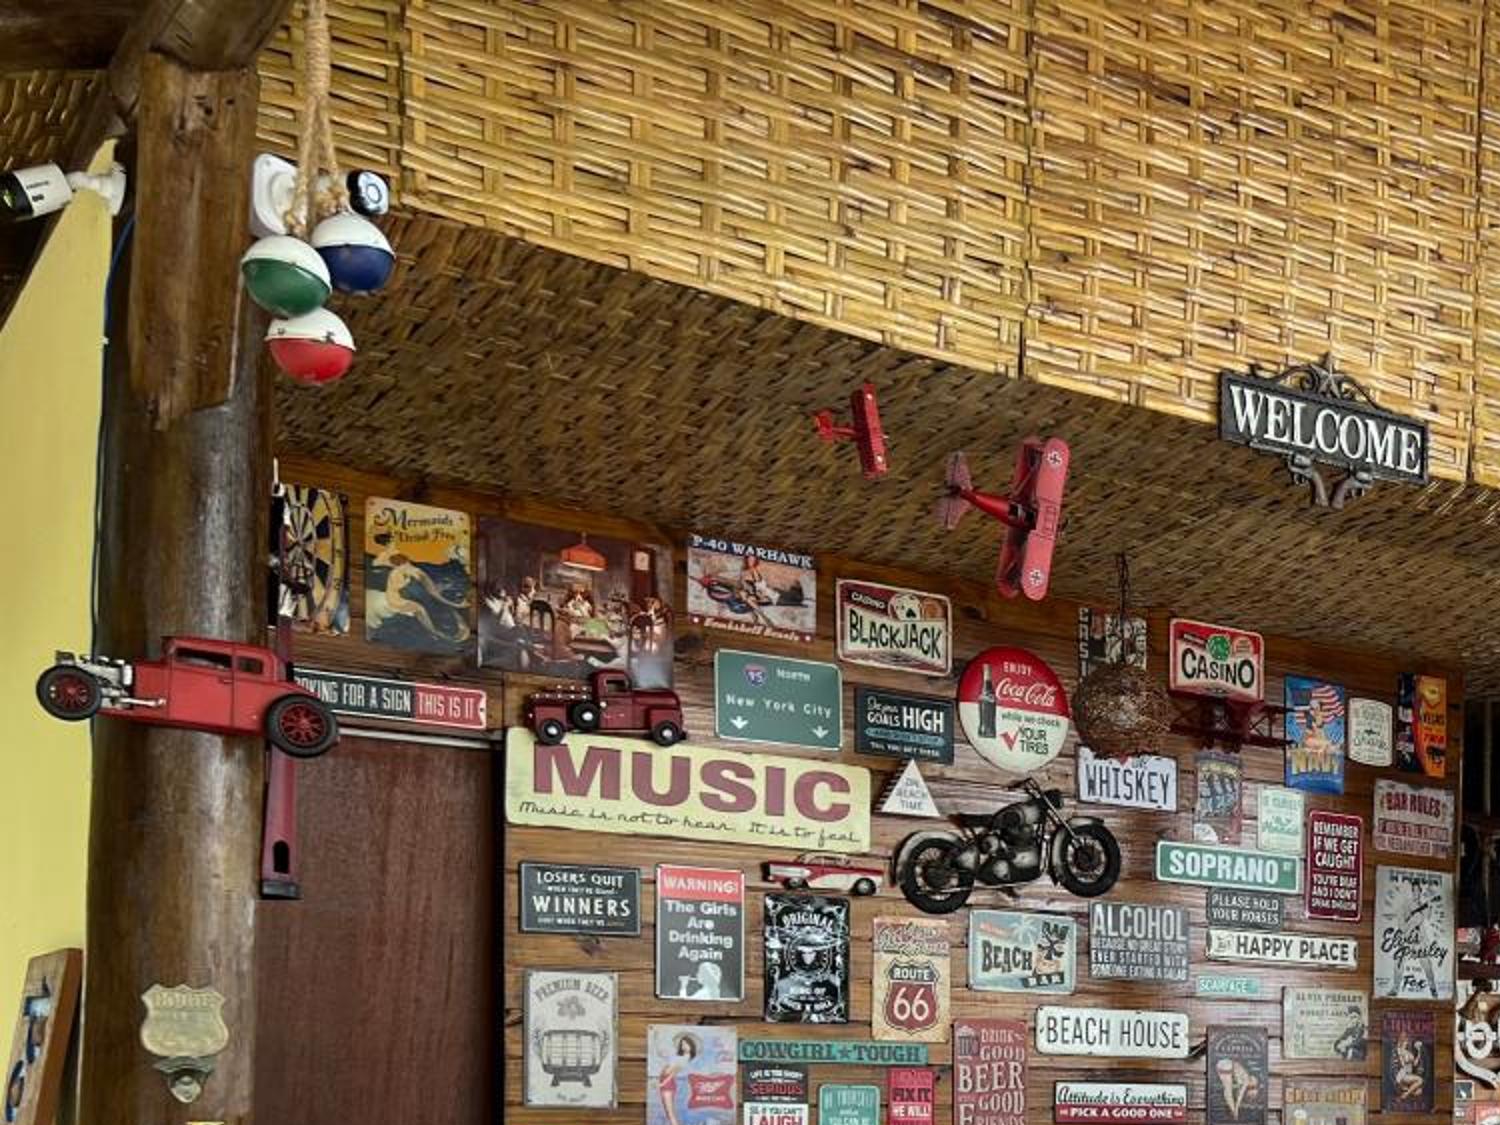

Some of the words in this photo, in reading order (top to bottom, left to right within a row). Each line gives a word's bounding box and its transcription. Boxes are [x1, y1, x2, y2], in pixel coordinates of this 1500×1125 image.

[1230, 384, 1422, 475] WELCOME
[849, 609, 943, 659] BLACKJACK
[1181, 648, 1255, 689] CASINO
[725, 693, 755, 707] New
[764, 698, 796, 714] York
[802, 702, 833, 719] City
[866, 712, 902, 727] GOALS
[902, 706, 945, 734] HIGH
[1018, 725, 1048, 742] YOUR
[1019, 739, 1049, 755] TIRES
[532, 741, 852, 824] MUSIC
[1085, 764, 1170, 805] WHISKEY
[1313, 821, 1360, 839] REMEMBER
[1313, 836, 1323, 850] IF
[1324, 837, 1339, 852] WE
[1341, 840, 1359, 855] GET
[1315, 852, 1357, 870] CAUGHT
[536, 871, 586, 886] LOSERS
[590, 873, 625, 889] QUIT
[662, 875, 739, 895] WARNING!
[531, 895, 632, 918] WINNERS
[664, 900, 695, 914] The
[699, 901, 738, 918] Girls
[1211, 893, 1251, 909] PLEASE
[1253, 896, 1280, 911] HOLD
[686, 916, 715, 931] Are
[782, 905, 837, 931] ORIGINAL
[1093, 903, 1187, 941] ALCOHOL
[1211, 907, 1239, 922] YOUR
[1241, 909, 1280, 925] HORSES
[668, 930, 734, 949] Drinking
[1236, 937, 1293, 958] HAPPY
[1300, 941, 1350, 963] PLACE
[677, 946, 724, 964] Again
[981, 939, 1033, 974] BEACH
[892, 968, 932, 982] ROUTE
[892, 986, 930, 1023] 66
[1046, 1015, 1108, 1046] BEACH
[1122, 1019, 1182, 1050] HOUSE
[741, 1041, 838, 1061] COWGIRL
[852, 1043, 921, 1064] TOUGH
[979, 1045, 1025, 1063] GOOD
[957, 1061, 1025, 1094] BEER
[892, 1104, 906, 1117] HE
[978, 1090, 1025, 1116] GOOD
[1069, 1107, 1100, 1119] PICK
[1102, 1108, 1109, 1118] A
[1111, 1108, 1147, 1119] GOOD
[1149, 1109, 1173, 1119] ONE
